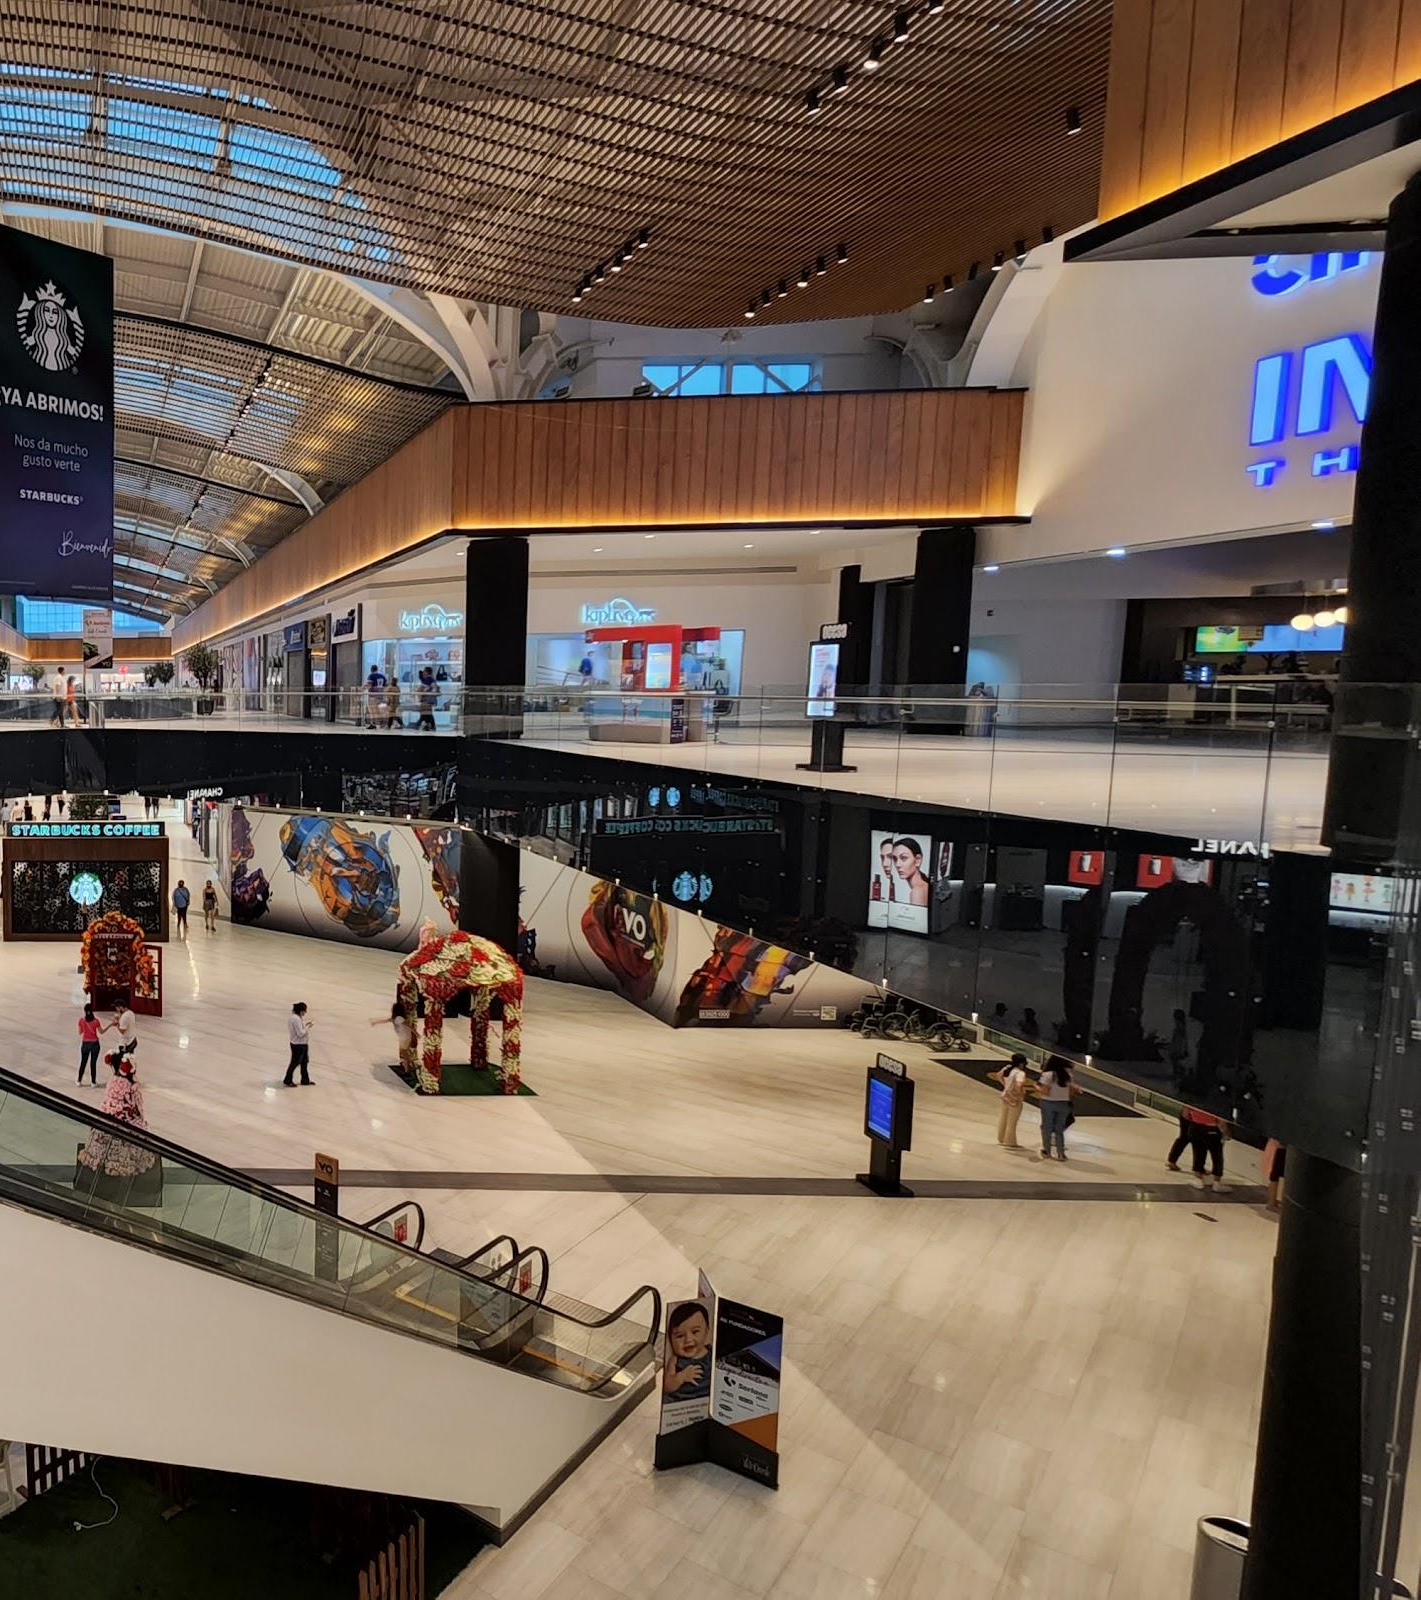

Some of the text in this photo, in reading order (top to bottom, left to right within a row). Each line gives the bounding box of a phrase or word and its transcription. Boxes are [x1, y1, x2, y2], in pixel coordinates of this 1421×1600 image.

[25, 391, 104, 422] ABRIMOS!
[14, 433, 89, 458] Nos da mucho
[22, 454, 81, 473] gusto verte
[11, 824, 161, 837] STARBUCKS COFFEE
[622, 907, 647, 941] VO
[318, 1161, 333, 1175] VO
[738, 1383, 769, 1400] Soriana
